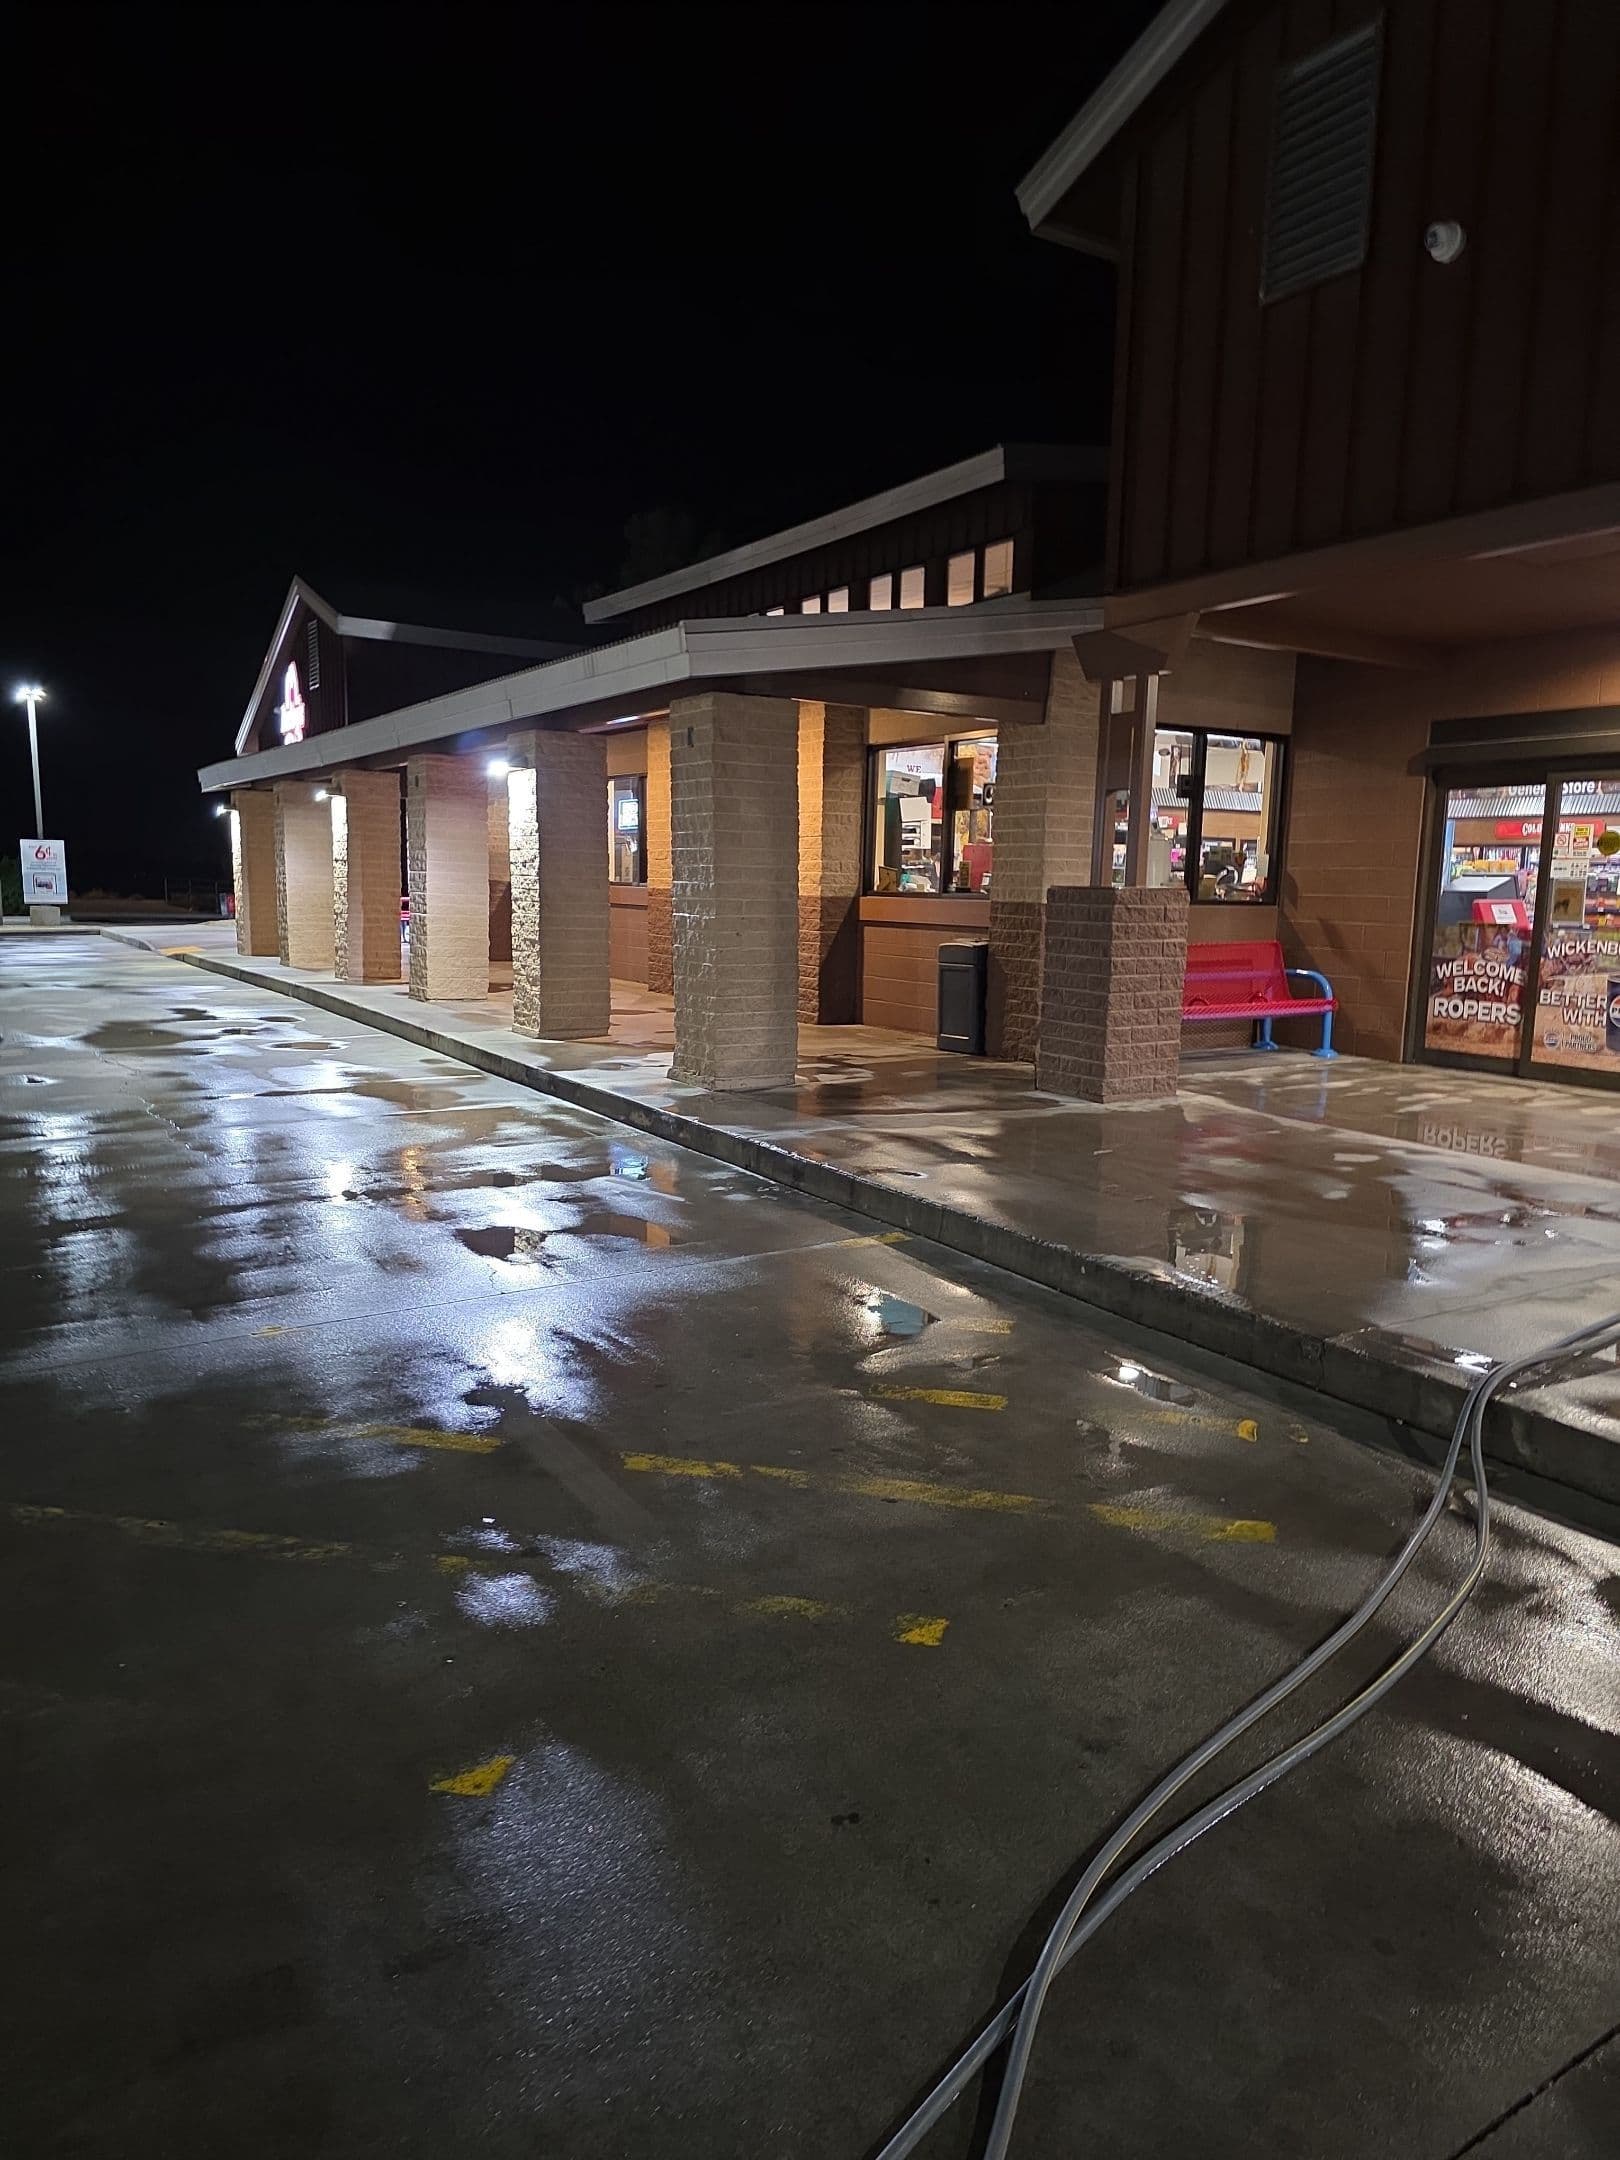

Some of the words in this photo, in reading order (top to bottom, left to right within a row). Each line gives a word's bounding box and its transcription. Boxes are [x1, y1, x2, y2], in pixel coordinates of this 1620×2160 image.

[1436, 959, 1525, 985] WELCOME
[1453, 976, 1506, 997] BACK!
[1539, 988, 1607, 1010] BETTER
[1434, 997, 1521, 1025] ROPERS
[1562, 1006, 1607, 1028] WITH
